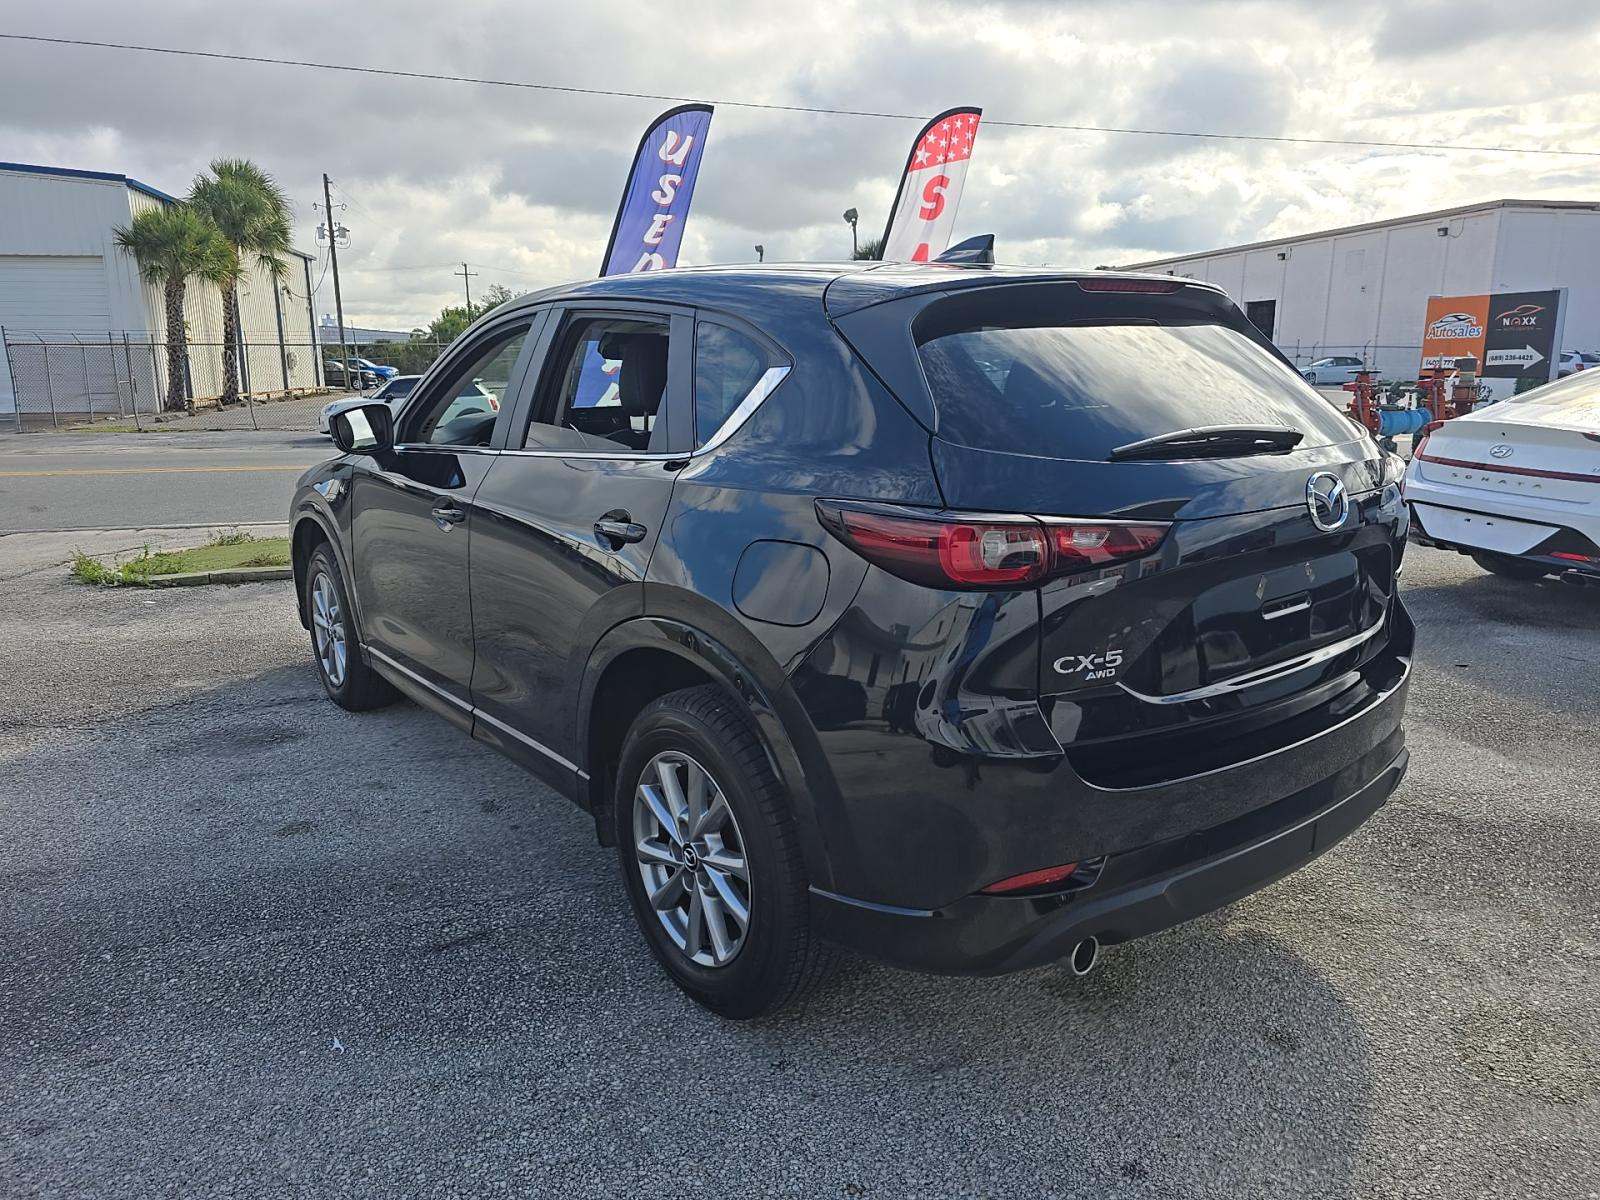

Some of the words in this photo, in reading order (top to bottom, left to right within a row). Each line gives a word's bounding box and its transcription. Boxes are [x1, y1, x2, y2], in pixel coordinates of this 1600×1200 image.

[1427, 324, 1482, 338] Autosales
[1451, 472, 1543, 489] SONATA
[1053, 649, 1123, 674] CX-5
[1085, 668, 1116, 681] AWD
